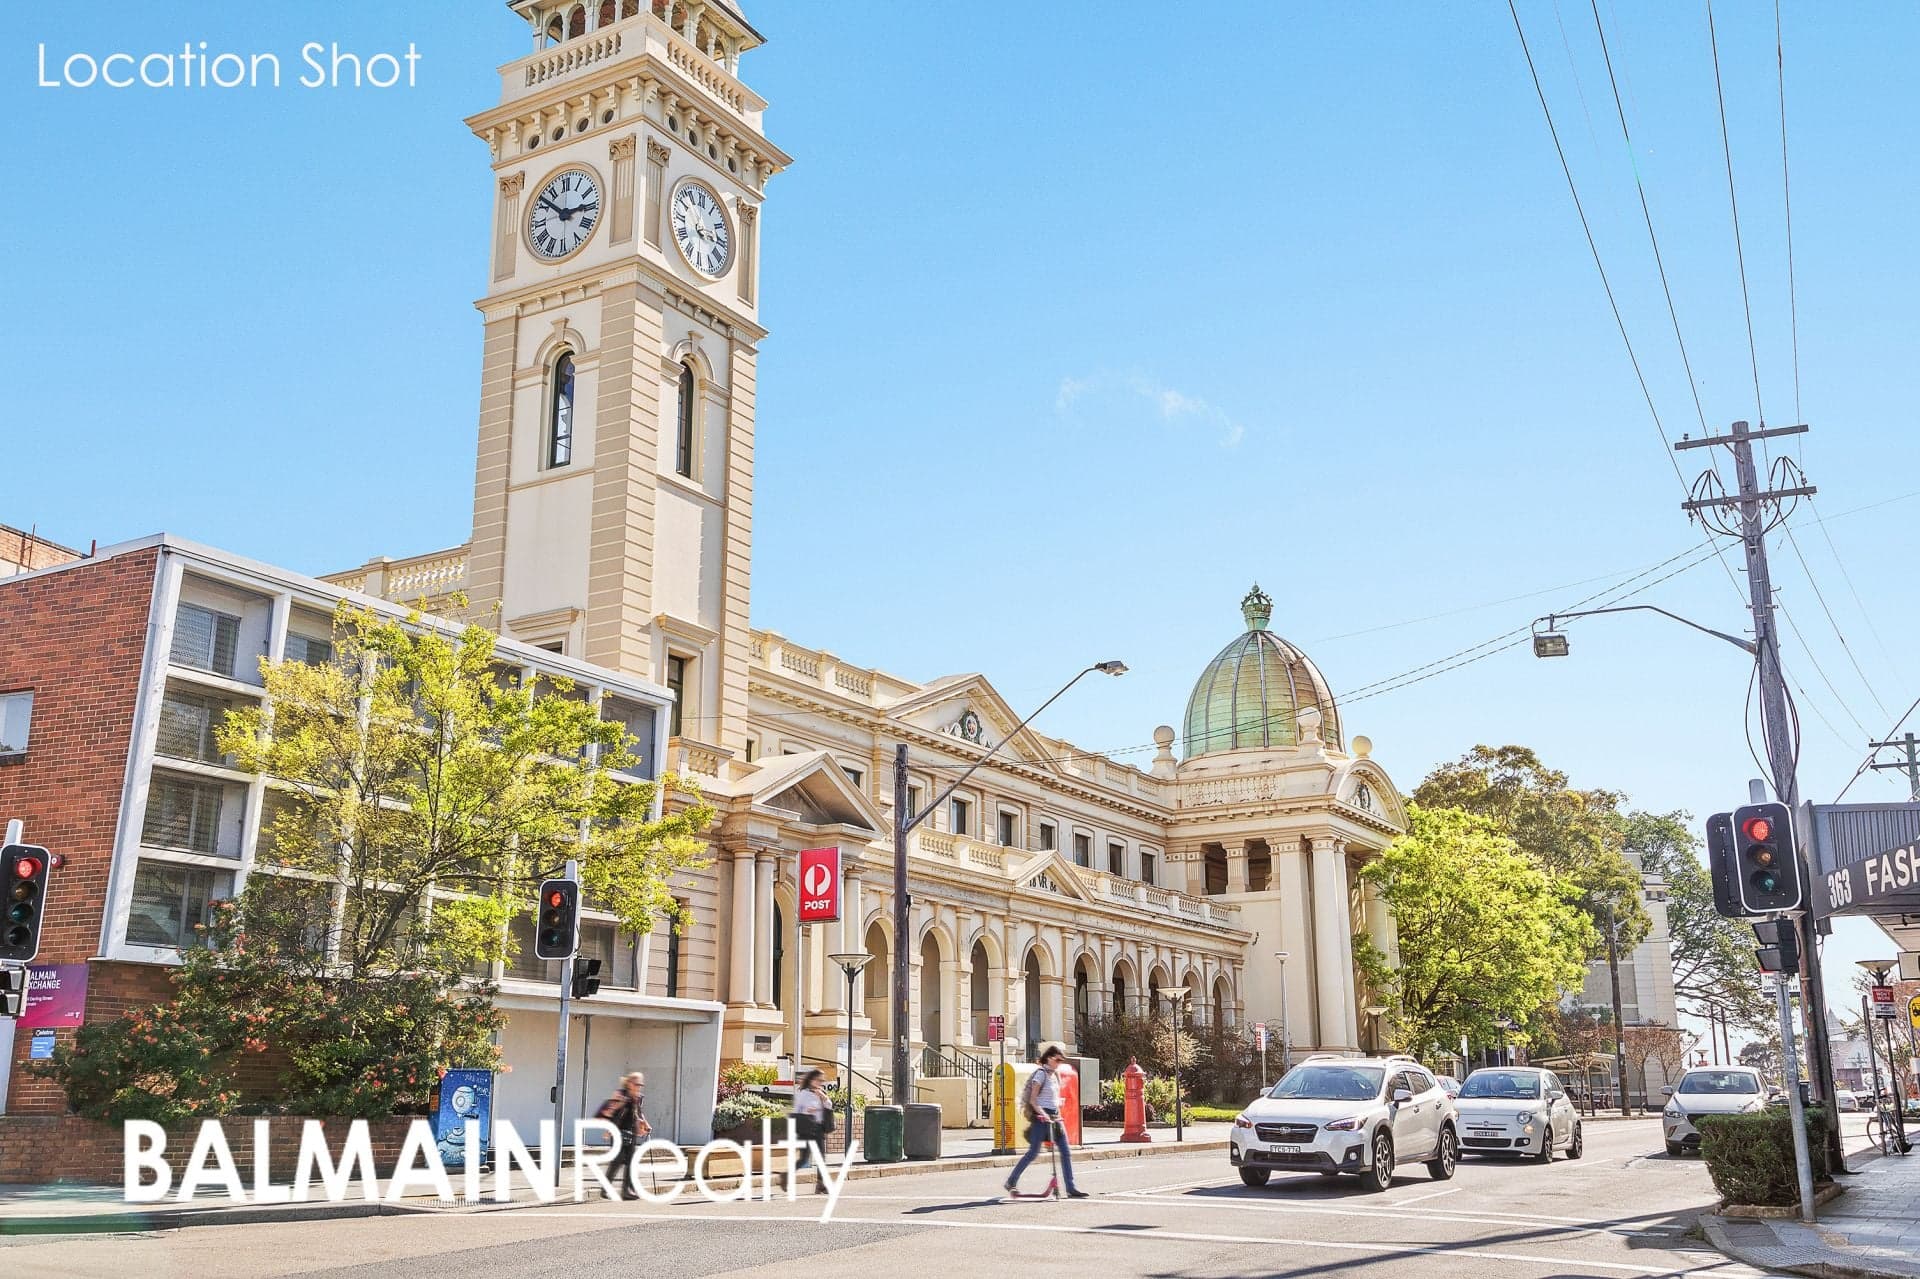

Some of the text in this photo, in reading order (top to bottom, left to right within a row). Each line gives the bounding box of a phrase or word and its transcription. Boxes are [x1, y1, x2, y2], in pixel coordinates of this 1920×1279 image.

[1827, 868, 1852, 909] 363
[804, 899, 831, 911] POST
[29, 970, 57, 980] ALMAIN
[28, 979, 61, 989] XCHANGE
